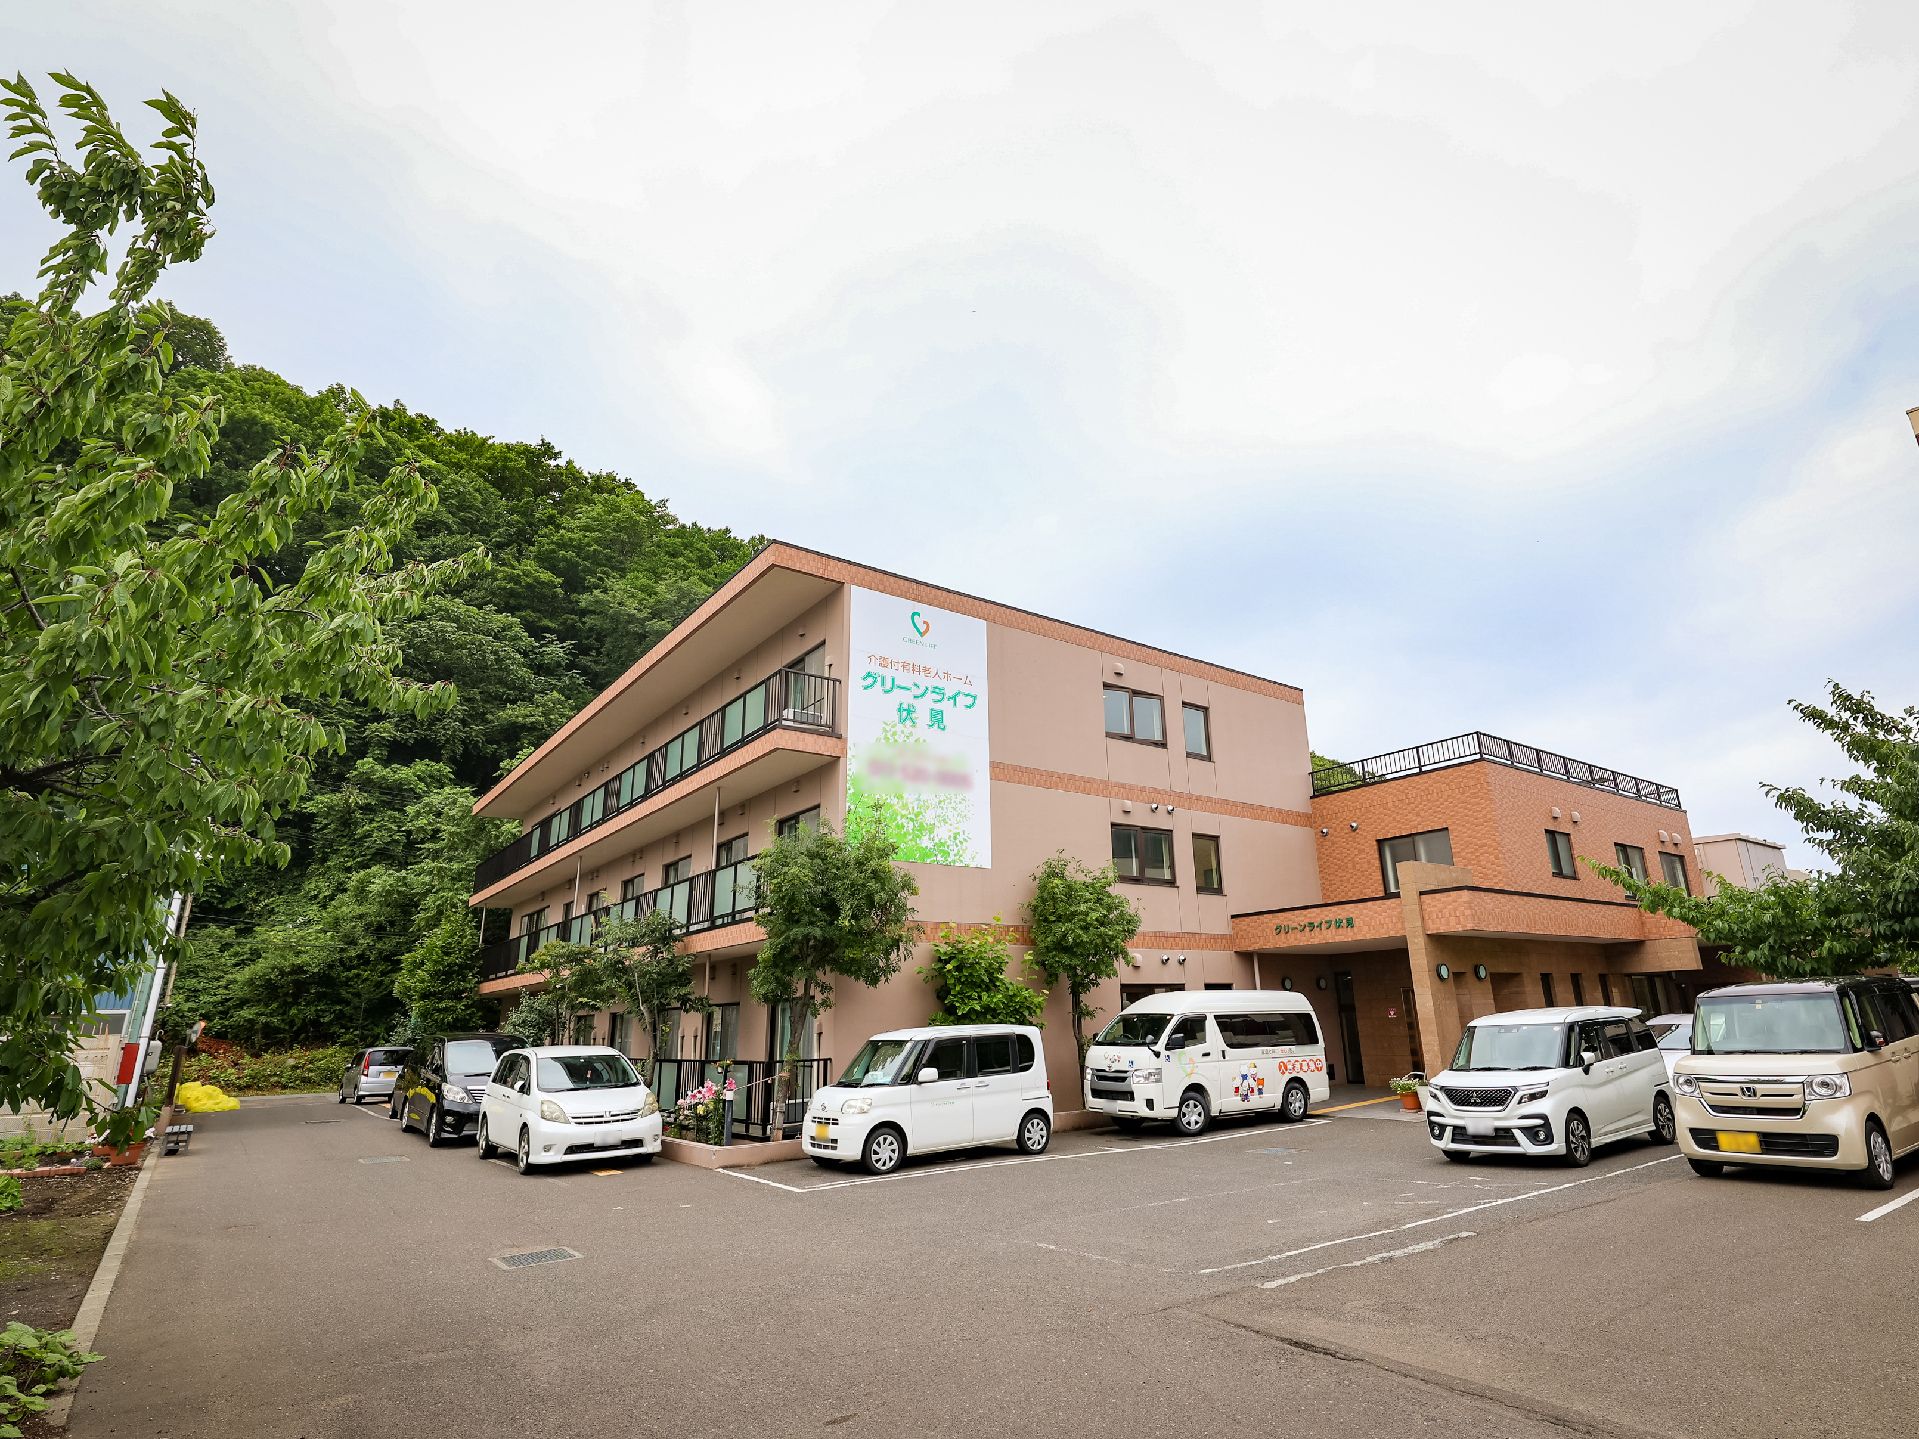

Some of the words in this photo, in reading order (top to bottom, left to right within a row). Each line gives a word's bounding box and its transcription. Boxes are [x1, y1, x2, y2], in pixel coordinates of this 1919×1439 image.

[867, 654, 973, 686] 介護付有料老人ホーム
[861, 671, 978, 709] グリーンライフ
[897, 701, 946, 731] 伏見
